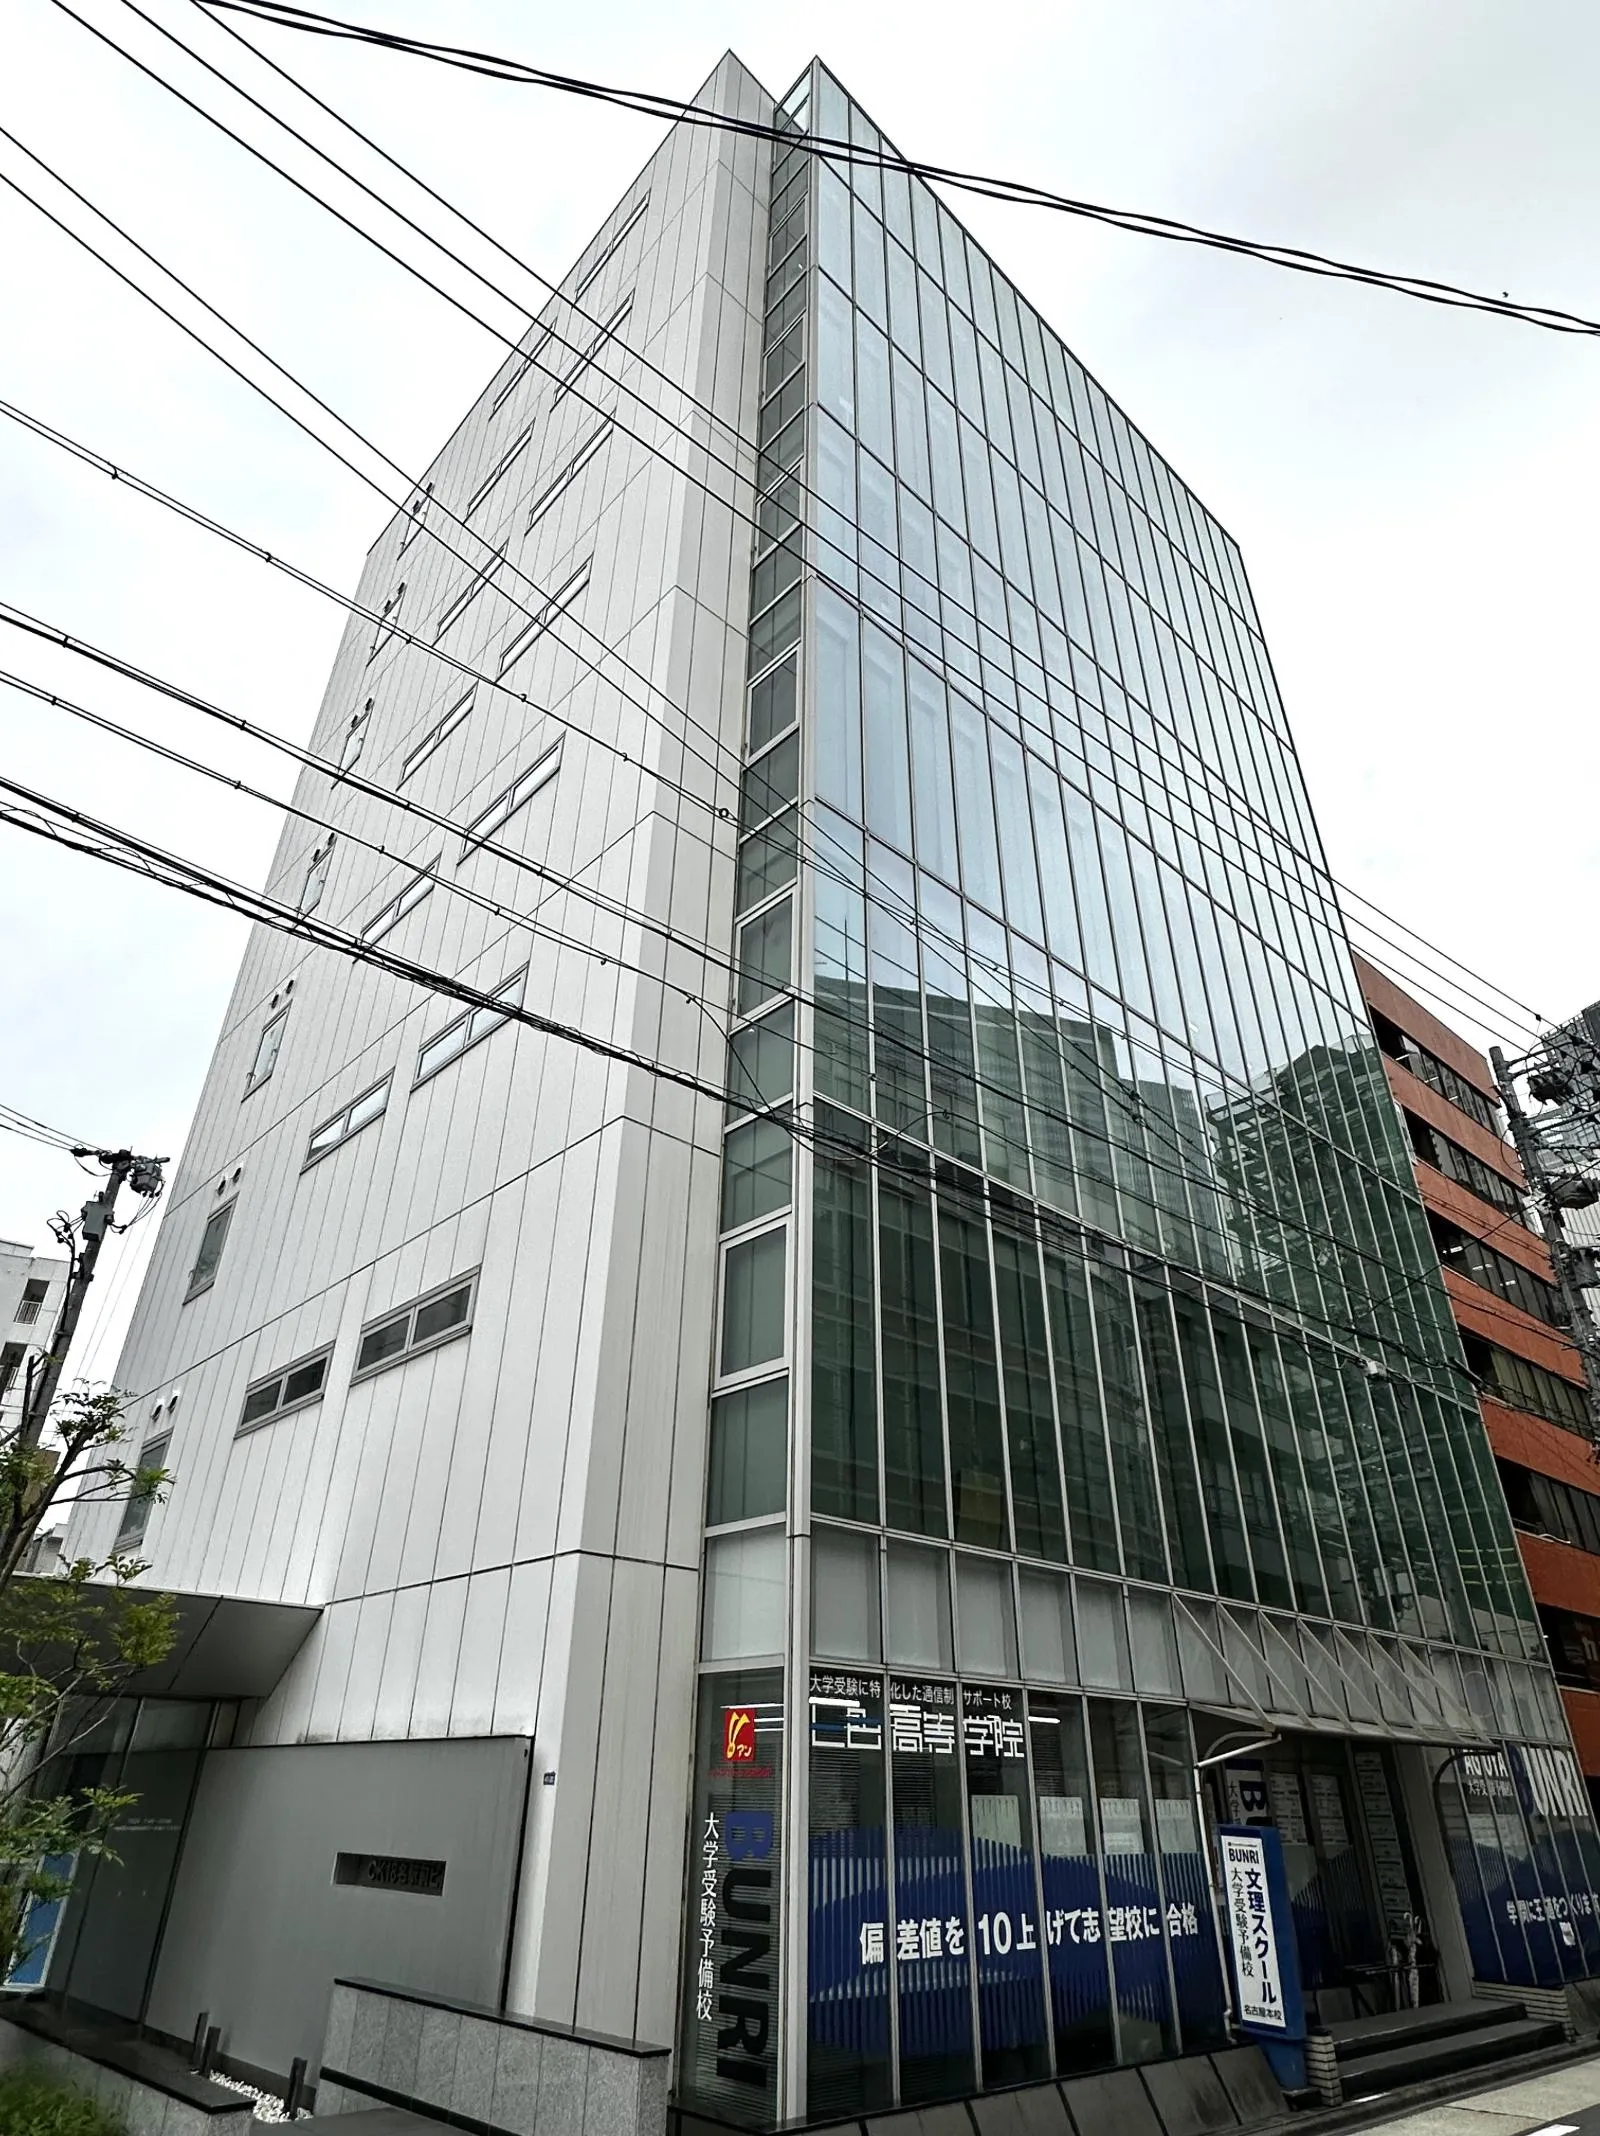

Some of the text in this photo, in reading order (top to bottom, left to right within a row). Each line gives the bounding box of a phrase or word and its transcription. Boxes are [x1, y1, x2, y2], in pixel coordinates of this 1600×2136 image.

[1229, 1848, 1260, 1865] BUNRI
[696, 1812, 719, 2021] 大学受験予備校
[716, 1811, 774, 2089] BUNRI
[860, 1902, 1198, 1965] 偏差値を10上げて志望校に合格
[1231, 1867, 1254, 1978] 大学受験予備校
[1244, 1867, 1277, 2004] 文理スクール
[1244, 2004, 1282, 2021] 名古屋本校
